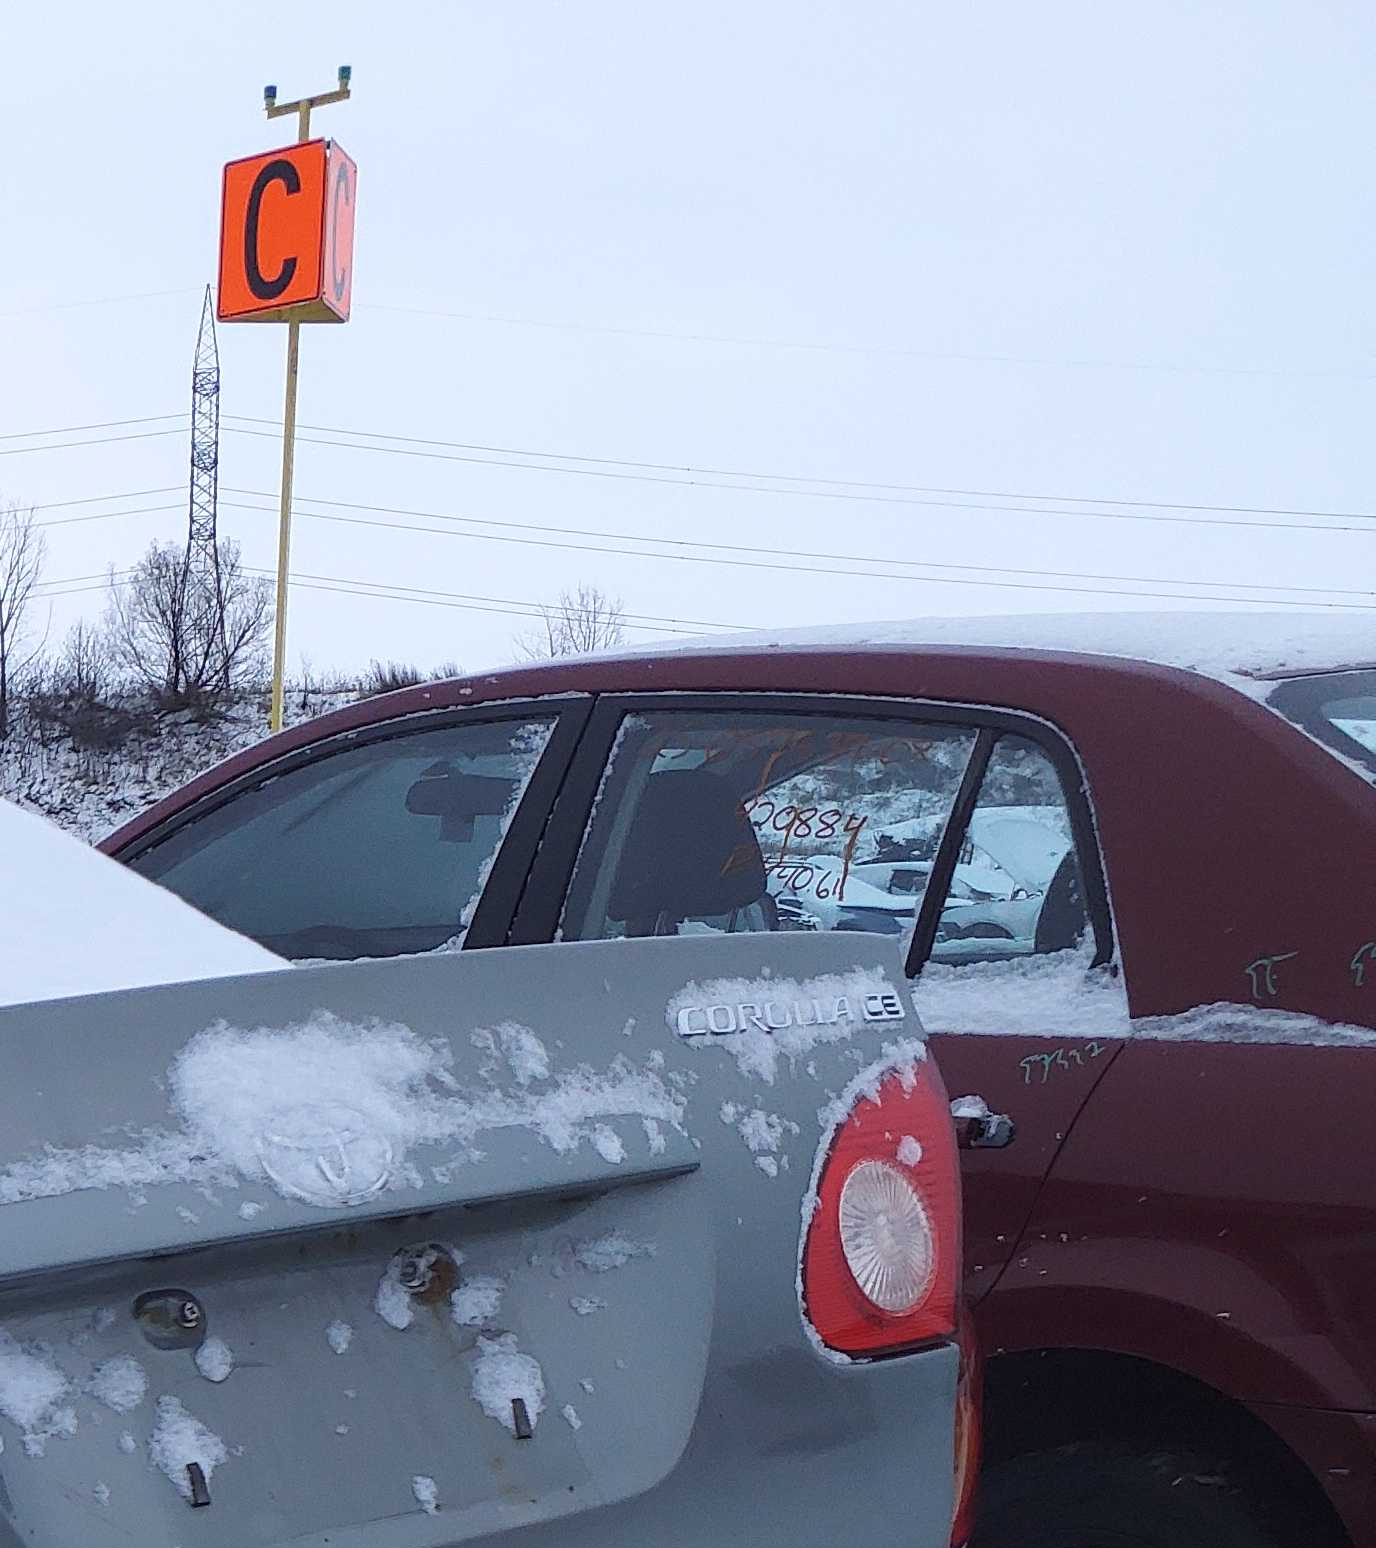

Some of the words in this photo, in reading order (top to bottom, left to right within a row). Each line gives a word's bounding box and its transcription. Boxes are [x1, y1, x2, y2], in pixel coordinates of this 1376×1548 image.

[244, 158, 301, 301] C
[332, 161, 350, 302] C
[862, 993, 905, 1022] CE
